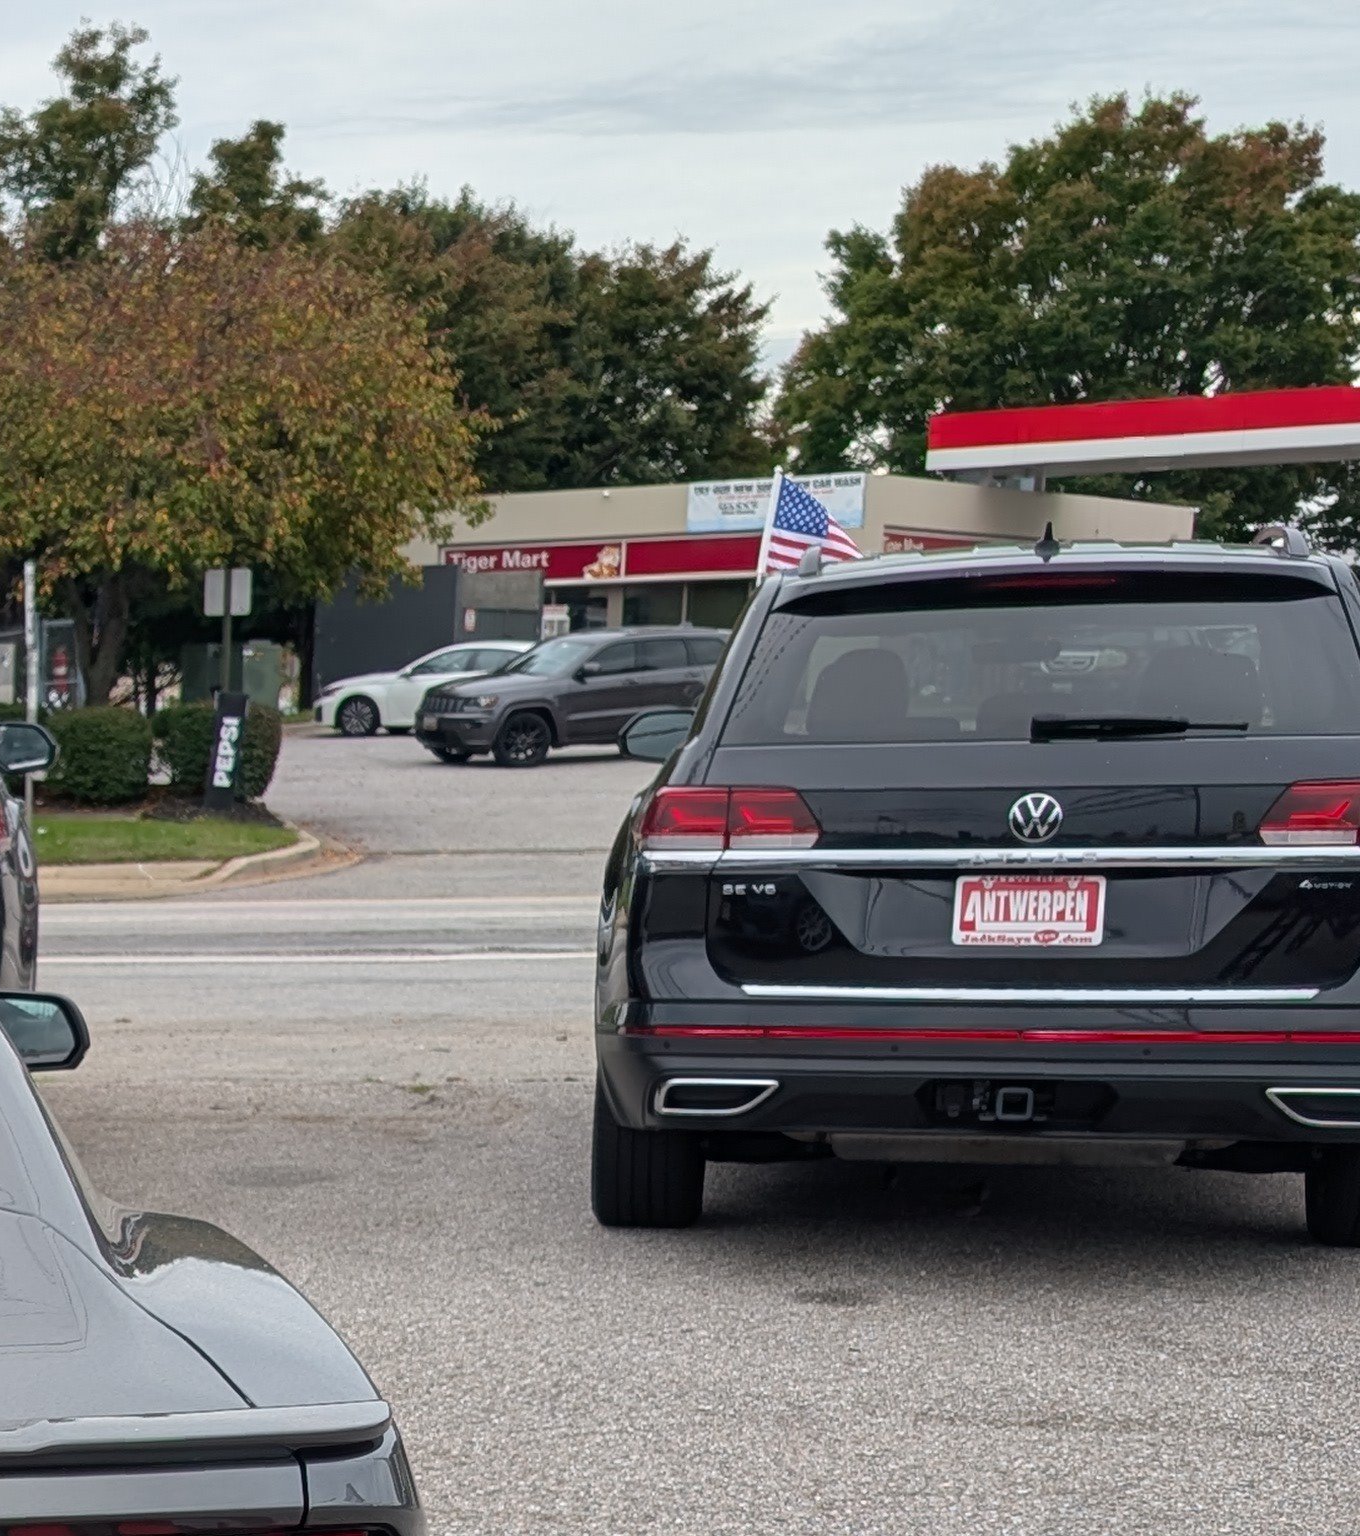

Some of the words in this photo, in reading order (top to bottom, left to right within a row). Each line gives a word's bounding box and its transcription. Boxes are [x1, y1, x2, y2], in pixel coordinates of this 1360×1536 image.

[449, 551, 498, 574] Tiger
[502, 550, 550, 568] Mart
[212, 716, 240, 788] PEPSI
[723, 884, 746, 895] SE
[751, 884, 776, 895] V6
[963, 889, 1089, 929] ANTWERPEN
